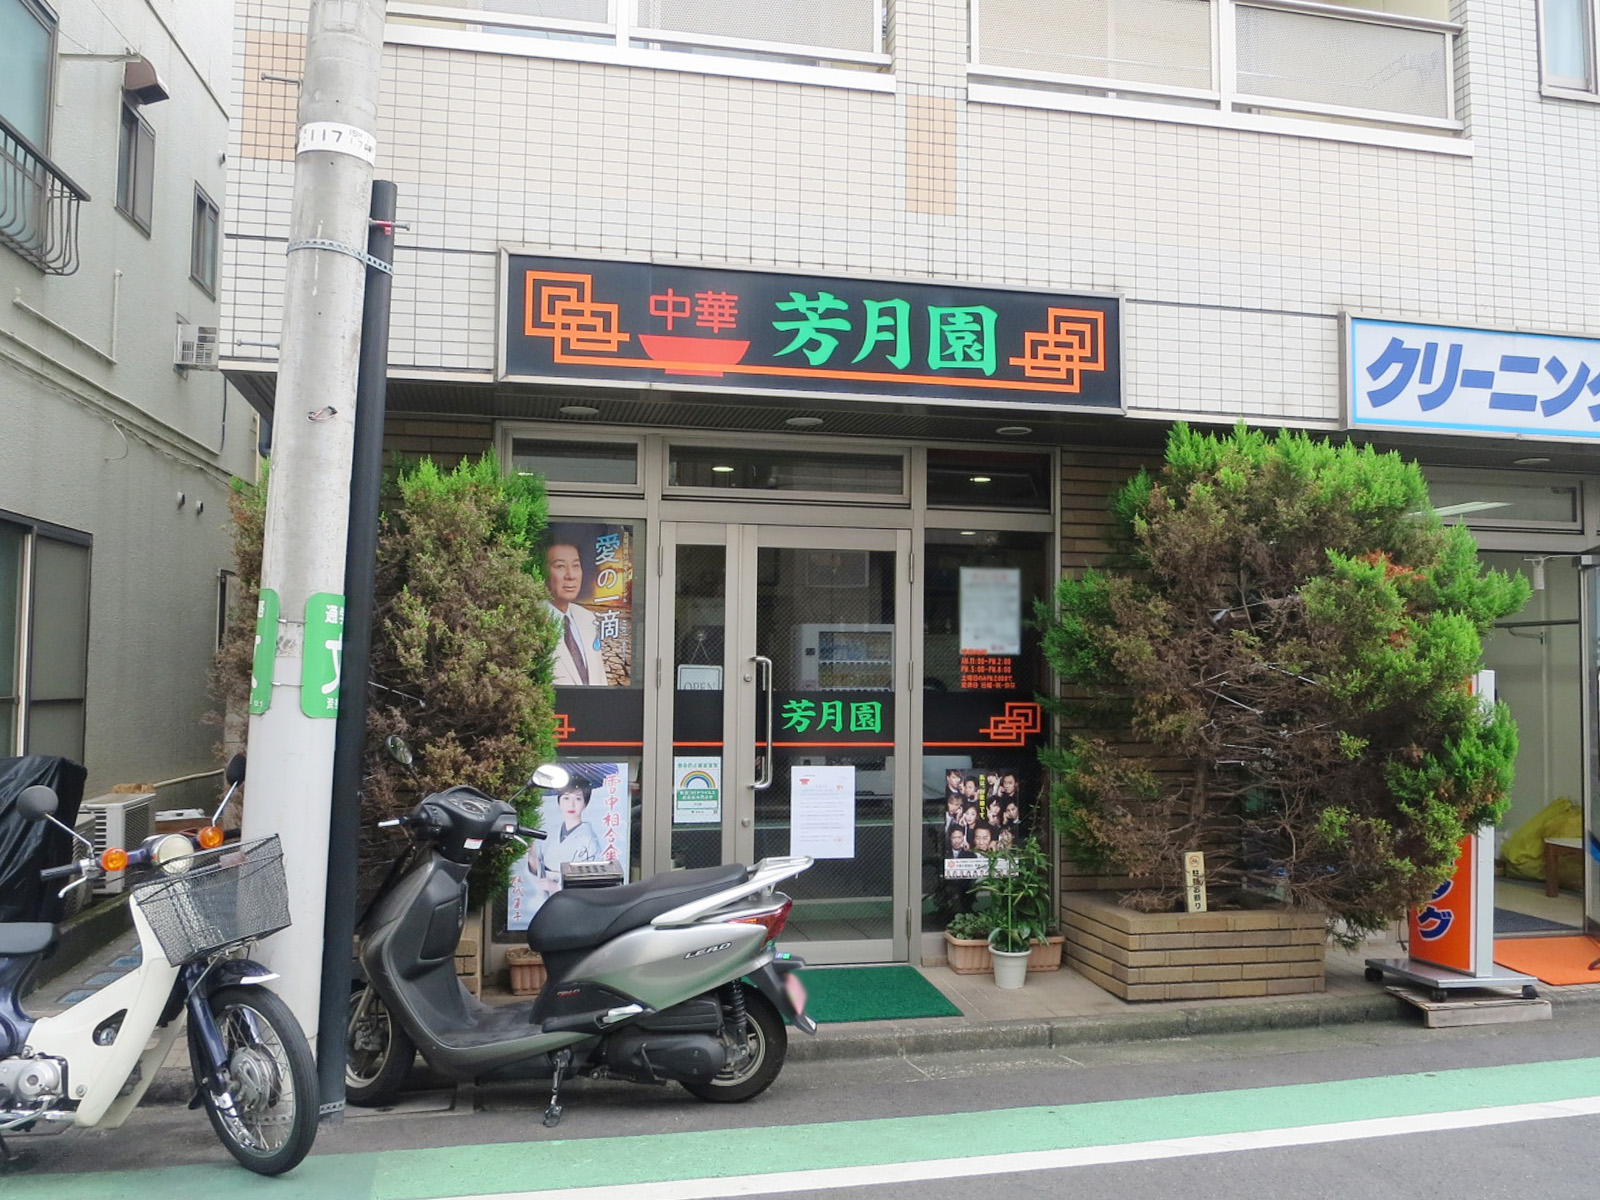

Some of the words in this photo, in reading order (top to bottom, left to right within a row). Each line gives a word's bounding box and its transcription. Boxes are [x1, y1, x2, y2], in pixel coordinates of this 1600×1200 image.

[311, 129, 342, 142] 117
[649, 287, 739, 333] 中華
[771, 291, 998, 376] 芳月園
[1366, 336, 1600, 424] クリーニン
[594, 533, 620, 640] 愛の一滴
[781, 699, 883, 734] 芳月園
[601, 775, 621, 861] 雪中相合傘
[684, 942, 732, 959] LEAD
